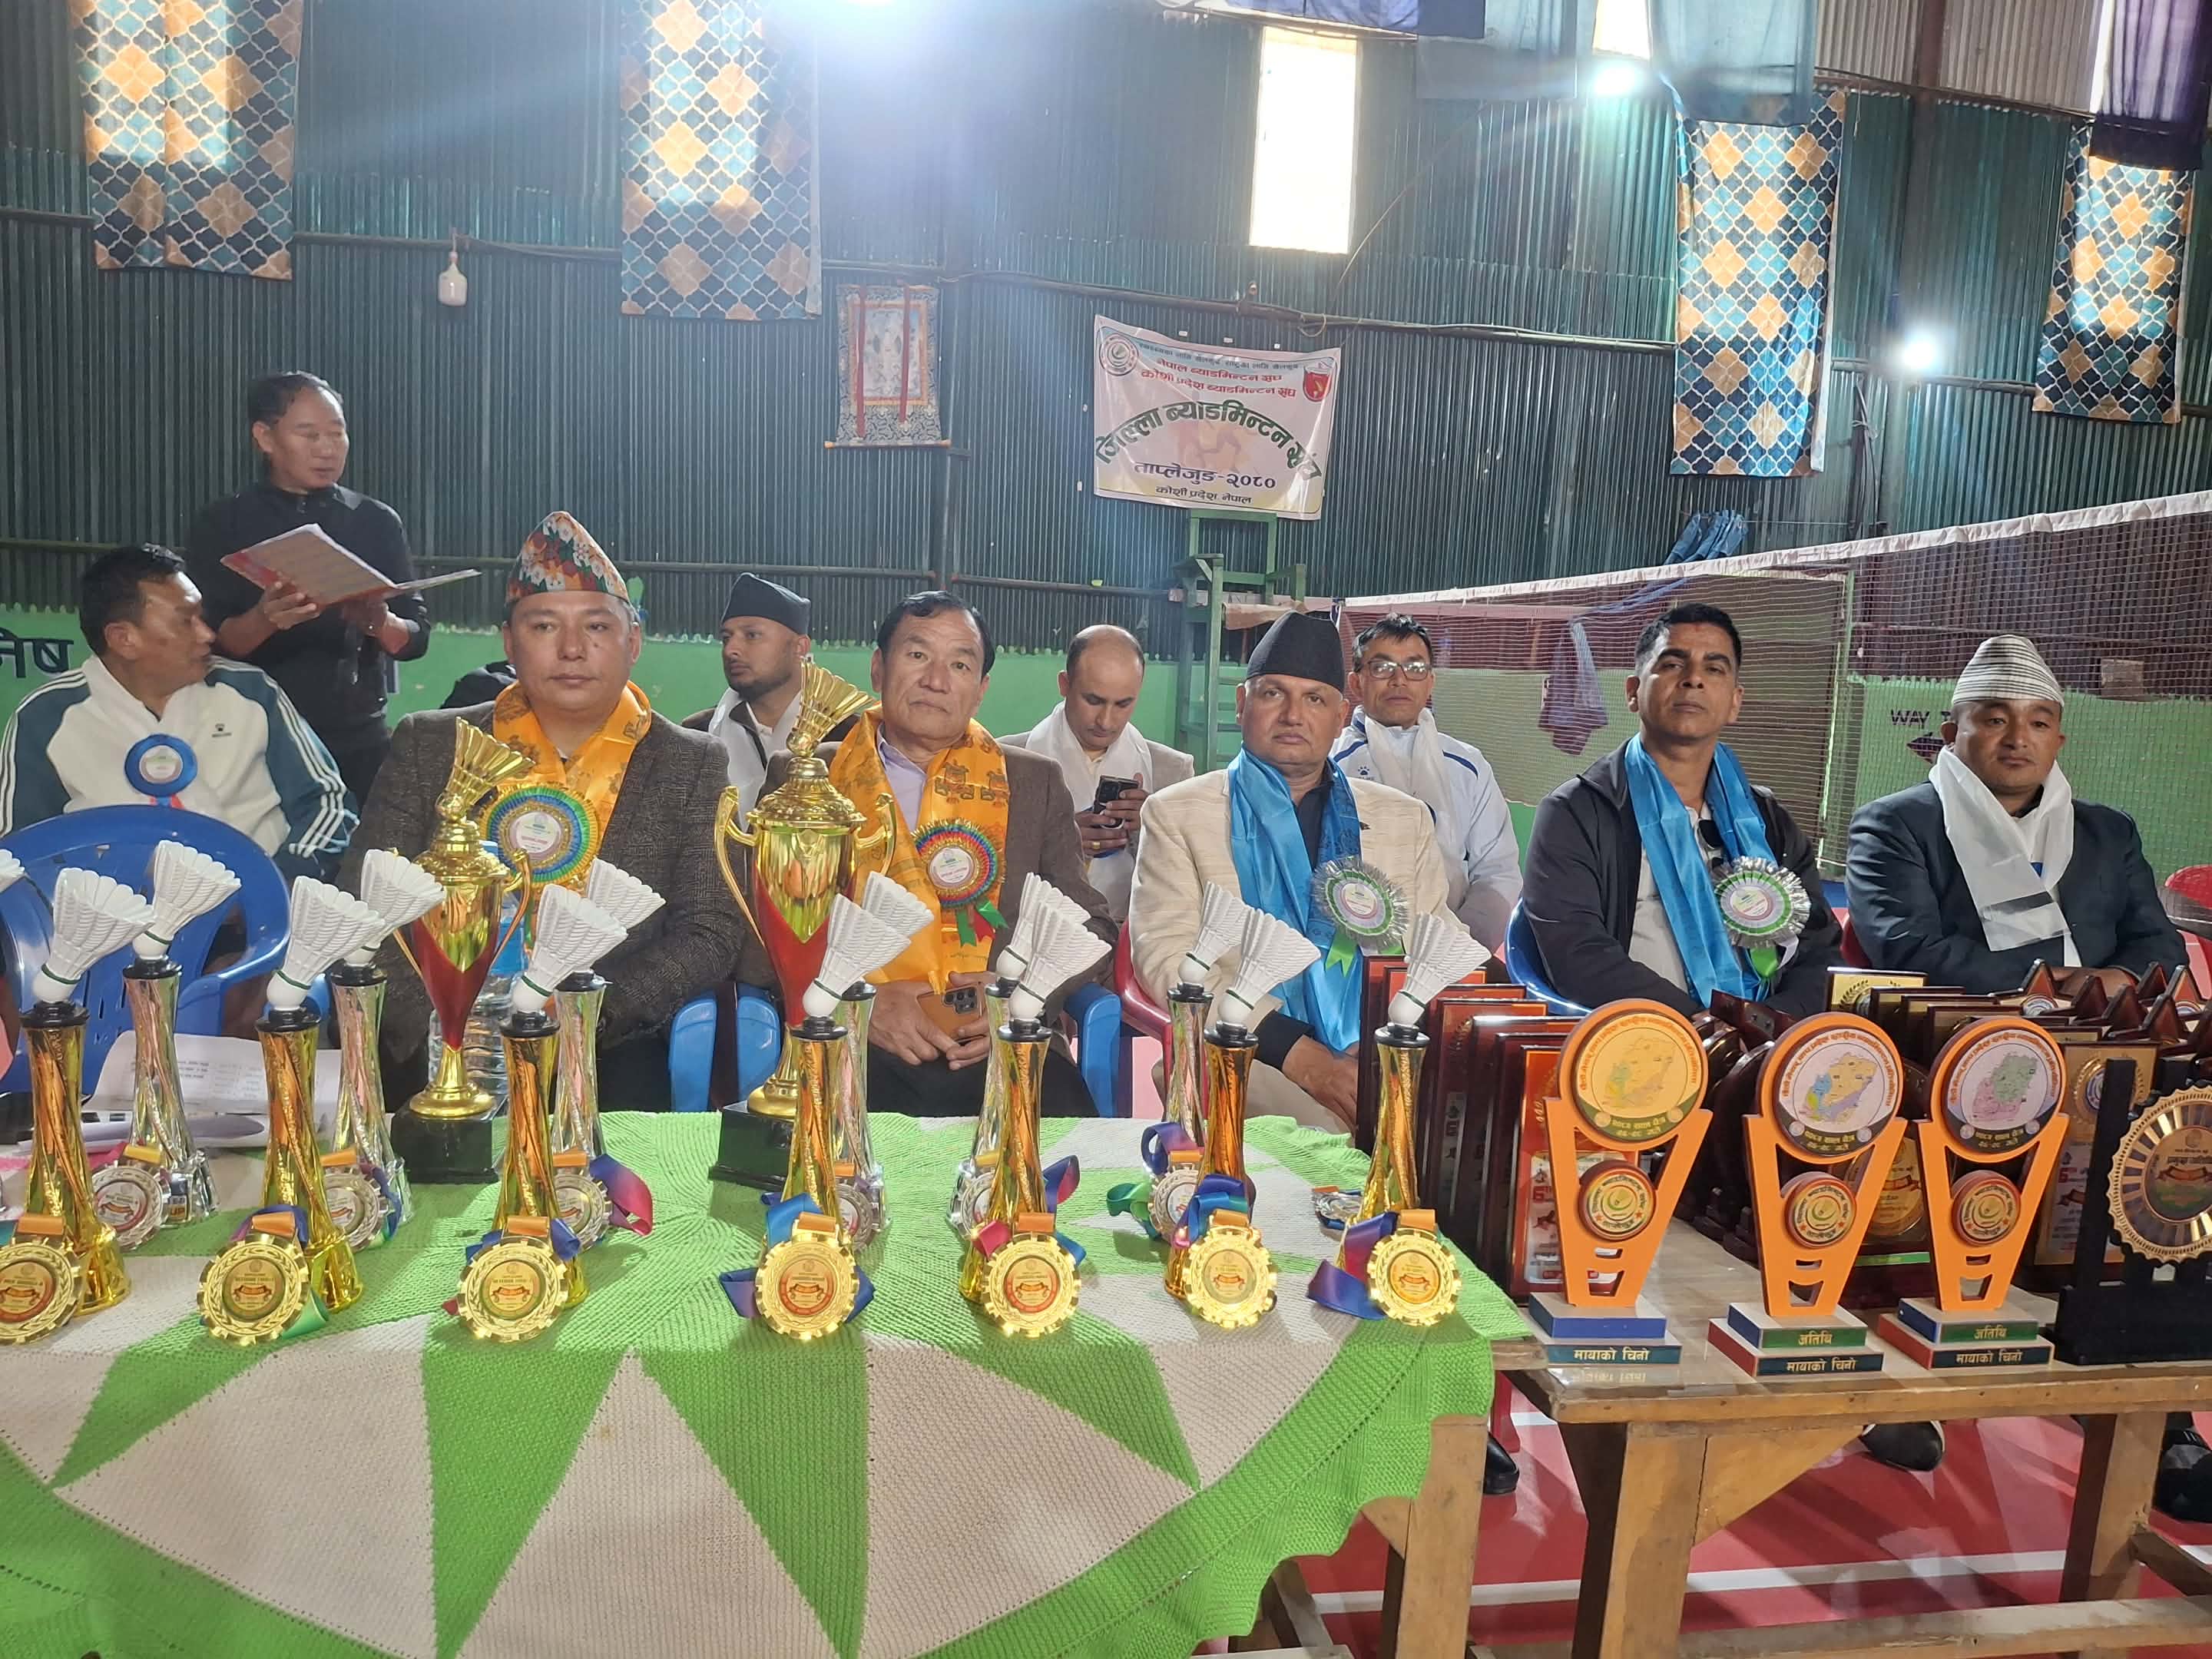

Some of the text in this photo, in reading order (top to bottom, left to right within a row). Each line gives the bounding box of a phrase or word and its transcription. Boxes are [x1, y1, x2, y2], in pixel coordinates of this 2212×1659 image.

[1157, 357, 1187, 373] नेपाल
[1141, 368, 1174, 382] कोशी
[1095, 407, 1164, 465] जिल्ला
[1162, 399, 1295, 449] ब्याडमिन्टन
[1155, 485, 1187, 498] कोशी
[1221, 492, 1252, 505] नेपाल
